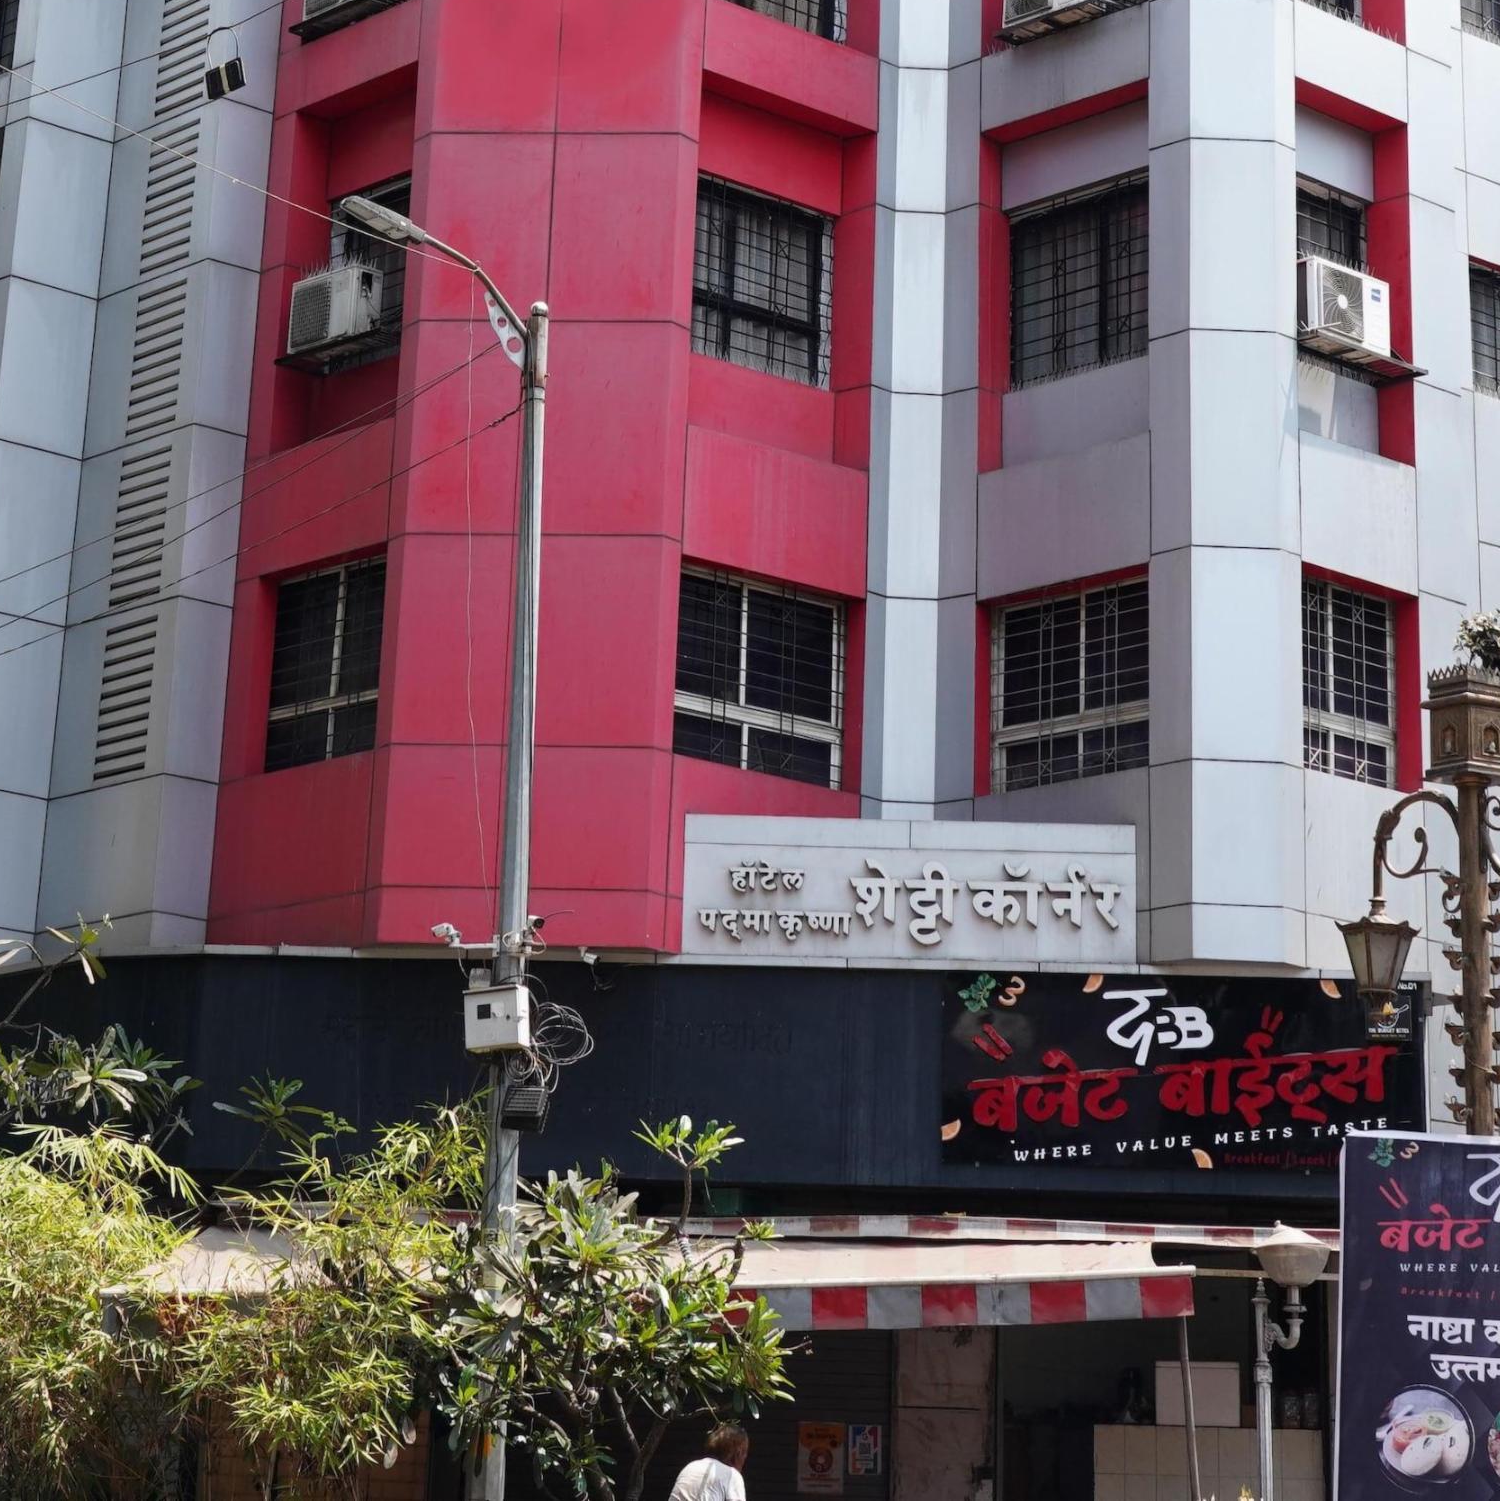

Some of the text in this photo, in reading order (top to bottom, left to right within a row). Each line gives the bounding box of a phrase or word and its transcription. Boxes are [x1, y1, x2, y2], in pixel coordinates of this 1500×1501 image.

[729, 860, 805, 892] हॉटेल
[850, 859, 1122, 946] शेट्टी कॉर्नर
[967, 1030, 1398, 1133] बजेट बाईट्स
[1013, 1117, 1389, 1163] WHERE VALUE MEETS TASTE
[1377, 1202, 1492, 1253] बजेट
[1399, 1262, 1459, 1274] WHERE
[1400, 1285, 1482, 1300] Breakfast
